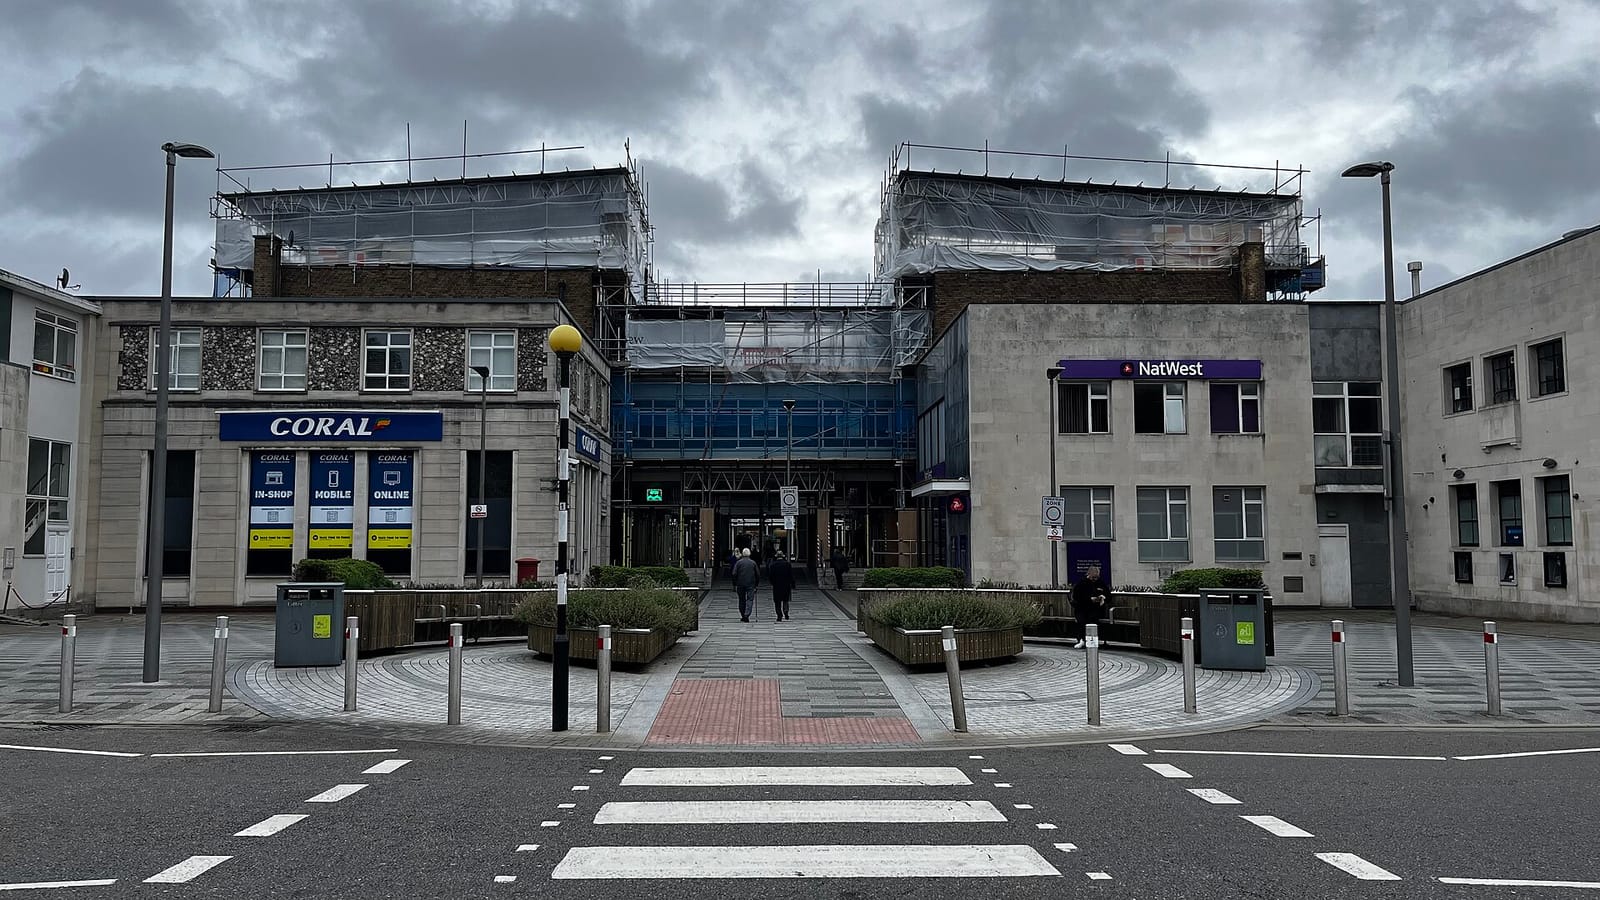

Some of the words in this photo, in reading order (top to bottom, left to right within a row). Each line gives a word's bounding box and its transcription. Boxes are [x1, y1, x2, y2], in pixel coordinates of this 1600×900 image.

[1139, 361, 1203, 376] NatWest
[270, 417, 373, 436] CORAL
[254, 490, 293, 499] IN-SHOP
[315, 490, 352, 499] MOBILE
[374, 490, 410, 499] ONLINE
